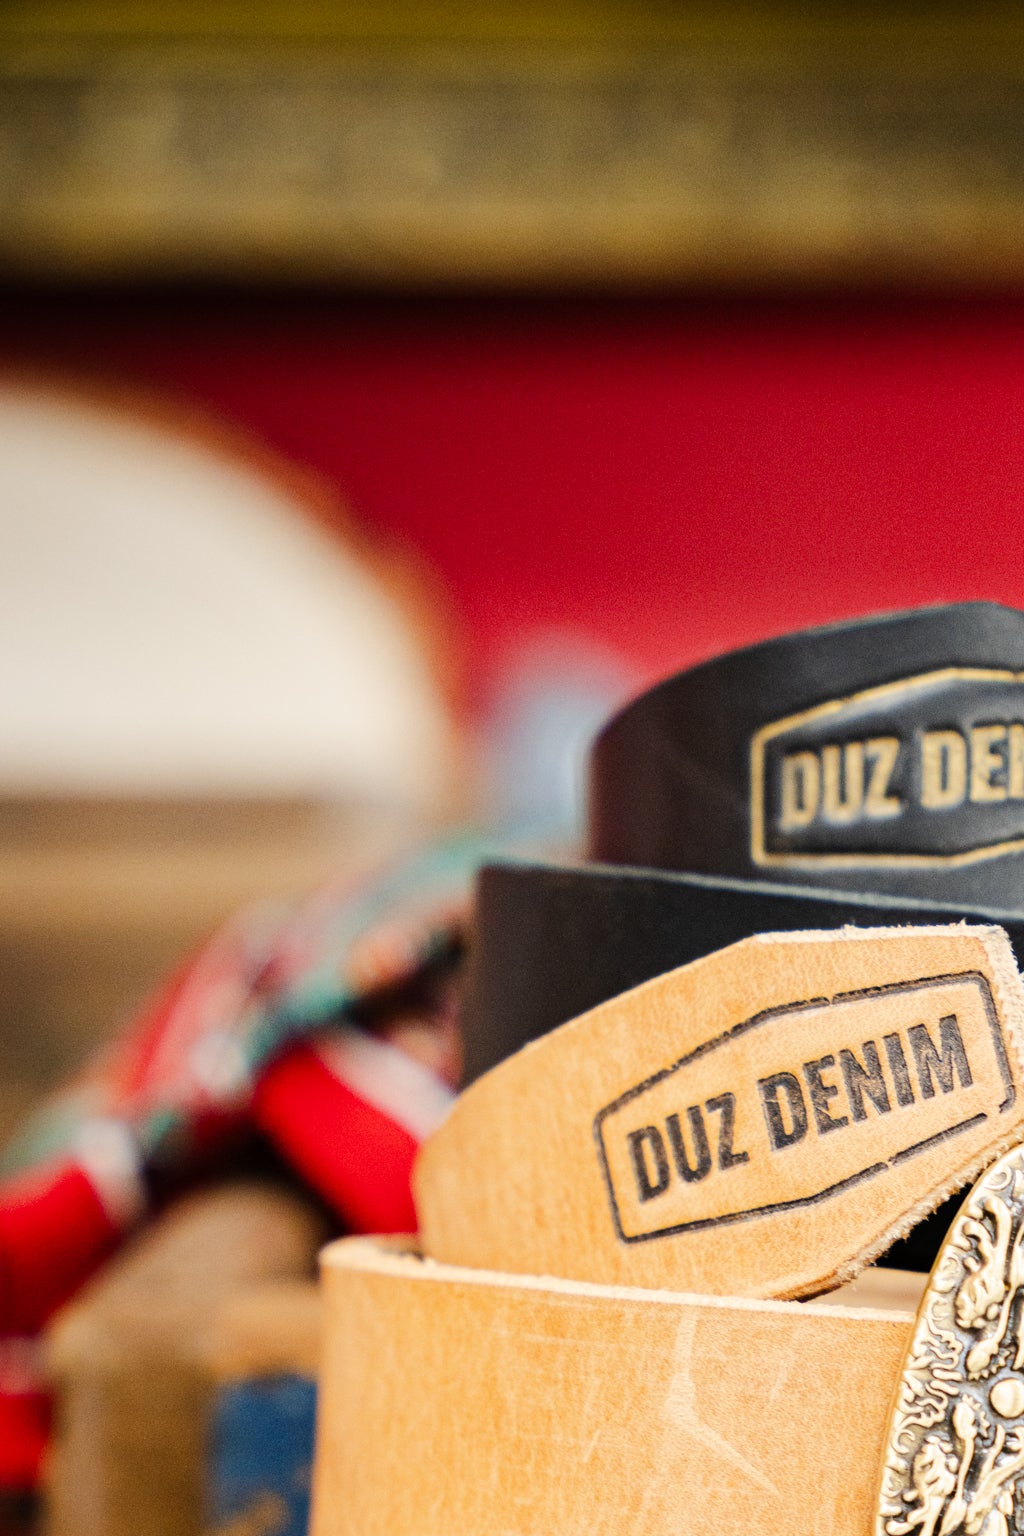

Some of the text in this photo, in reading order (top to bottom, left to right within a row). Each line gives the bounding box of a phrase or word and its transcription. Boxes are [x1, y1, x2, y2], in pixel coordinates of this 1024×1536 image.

[779, 737, 901, 832] DUZ
[627, 1014, 973, 1205] DUZ DENIM
